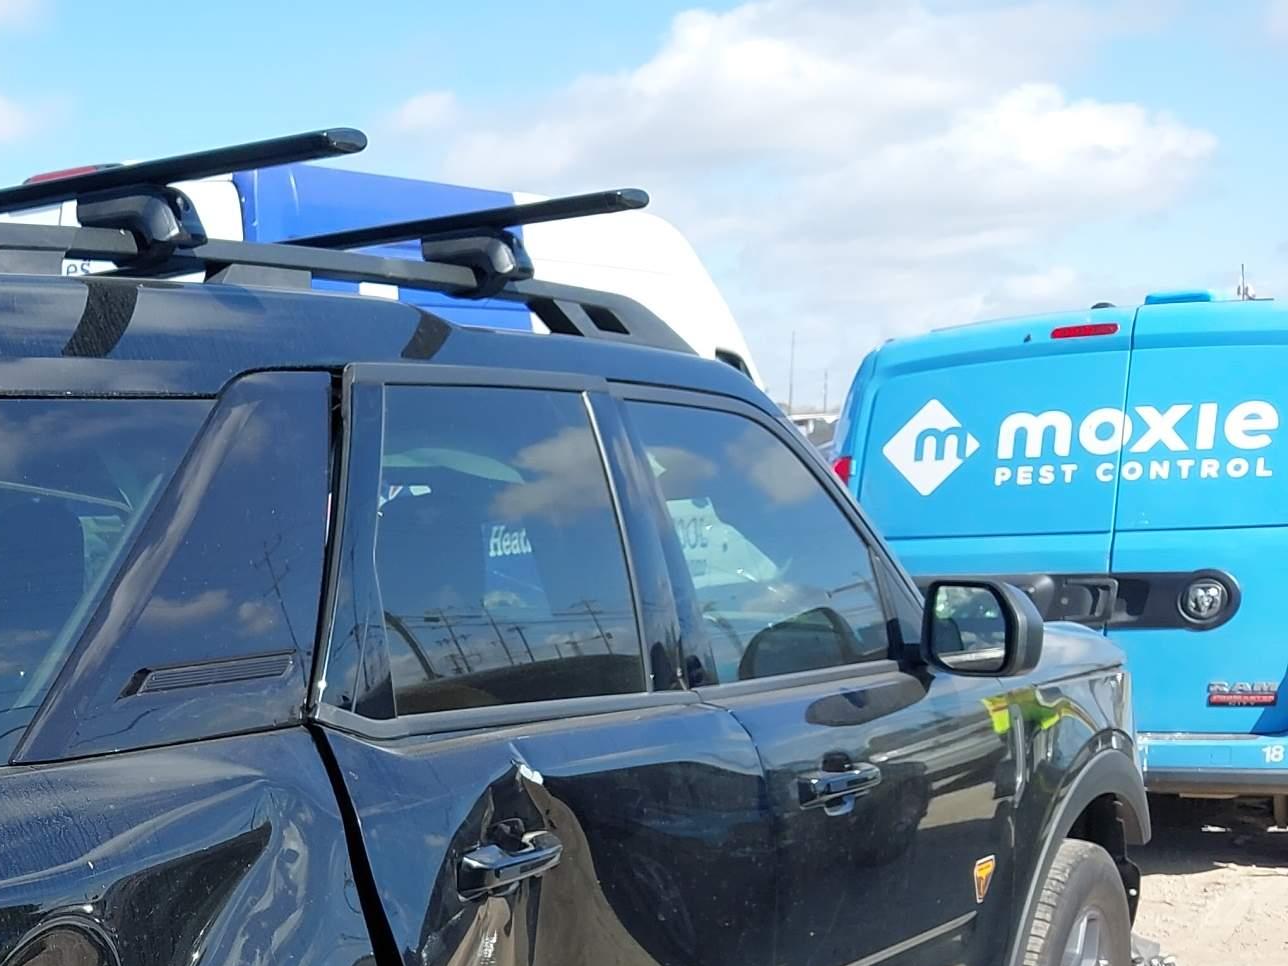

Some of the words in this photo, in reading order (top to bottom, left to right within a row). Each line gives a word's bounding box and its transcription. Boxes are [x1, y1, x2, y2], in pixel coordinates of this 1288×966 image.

[994, 463, 1079, 487] PEST
[1095, 457, 1273, 482] CONTROL
[1208, 681, 1277, 693] RAM
[1262, 745, 1285, 763] 18
